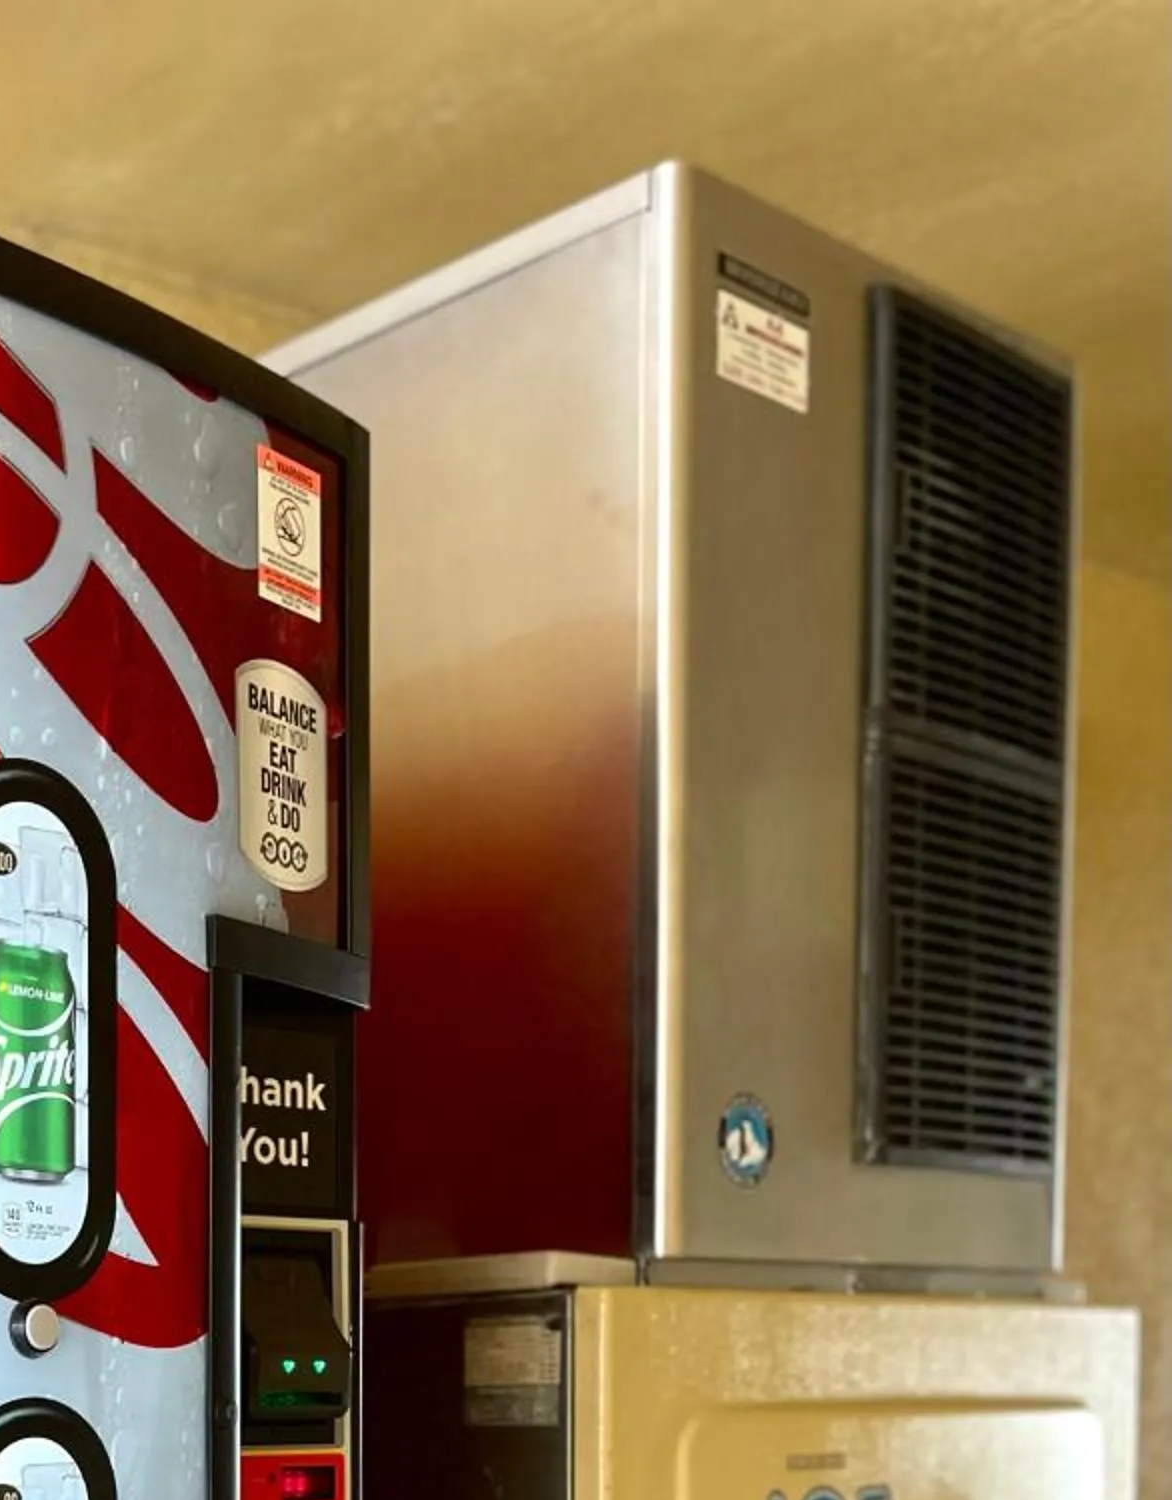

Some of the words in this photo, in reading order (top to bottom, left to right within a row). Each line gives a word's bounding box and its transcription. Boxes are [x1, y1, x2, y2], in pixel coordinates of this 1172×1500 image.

[248, 683, 317, 733] BALANCE
[258, 717, 286, 740] WHAT
[289, 729, 309, 750] YOU
[269, 742, 297, 773] EAT
[261, 768, 307, 807] DRINK
[268, 799, 278, 825] &
[280, 804, 300, 832] DO
[239, 1066, 326, 1111] hank
